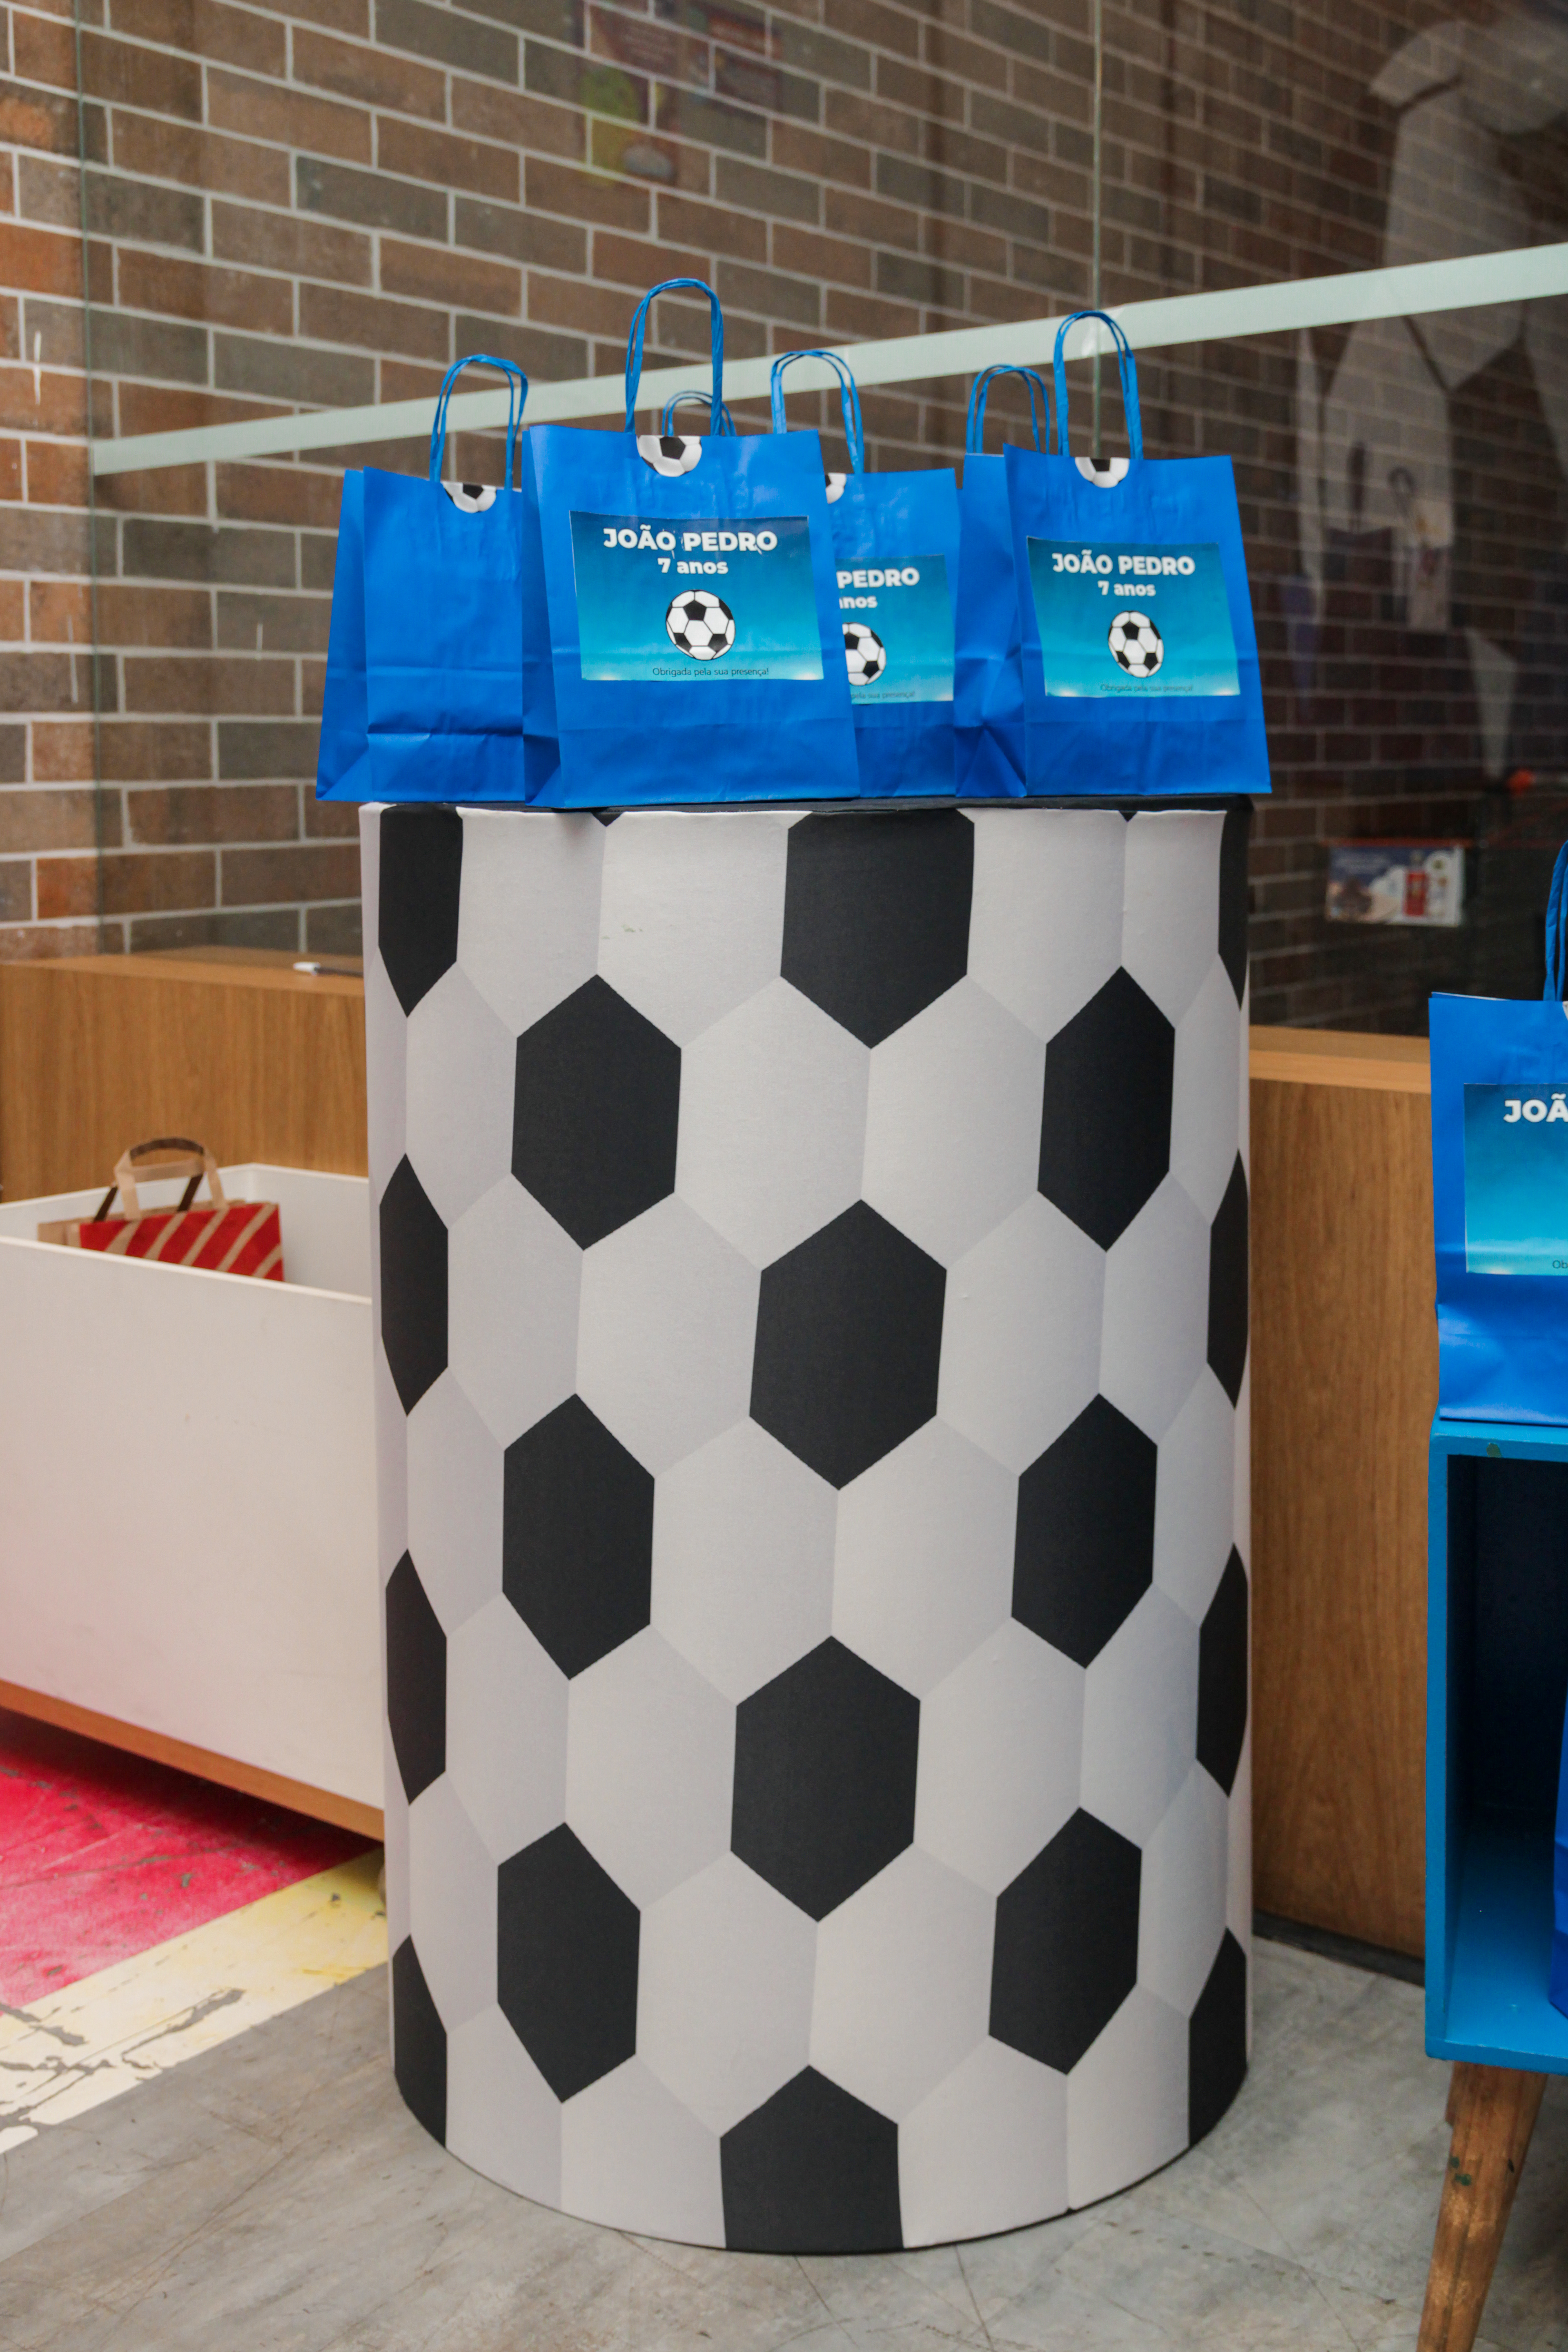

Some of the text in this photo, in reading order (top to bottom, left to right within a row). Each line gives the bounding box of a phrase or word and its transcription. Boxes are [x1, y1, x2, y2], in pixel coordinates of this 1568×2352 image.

[603, 524, 778, 551] JOÃO PEDRO
[657, 558, 729, 574] 7 anos
[1051, 549, 1196, 575] JOÃO PEDRO
[836, 567, 920, 588] PEDRO
[1097, 580, 1156, 597] 7 anos
[653, 667, 691, 677] Obrigada
[694, 668, 711, 677] pela
[731, 667, 769, 677] presença!
